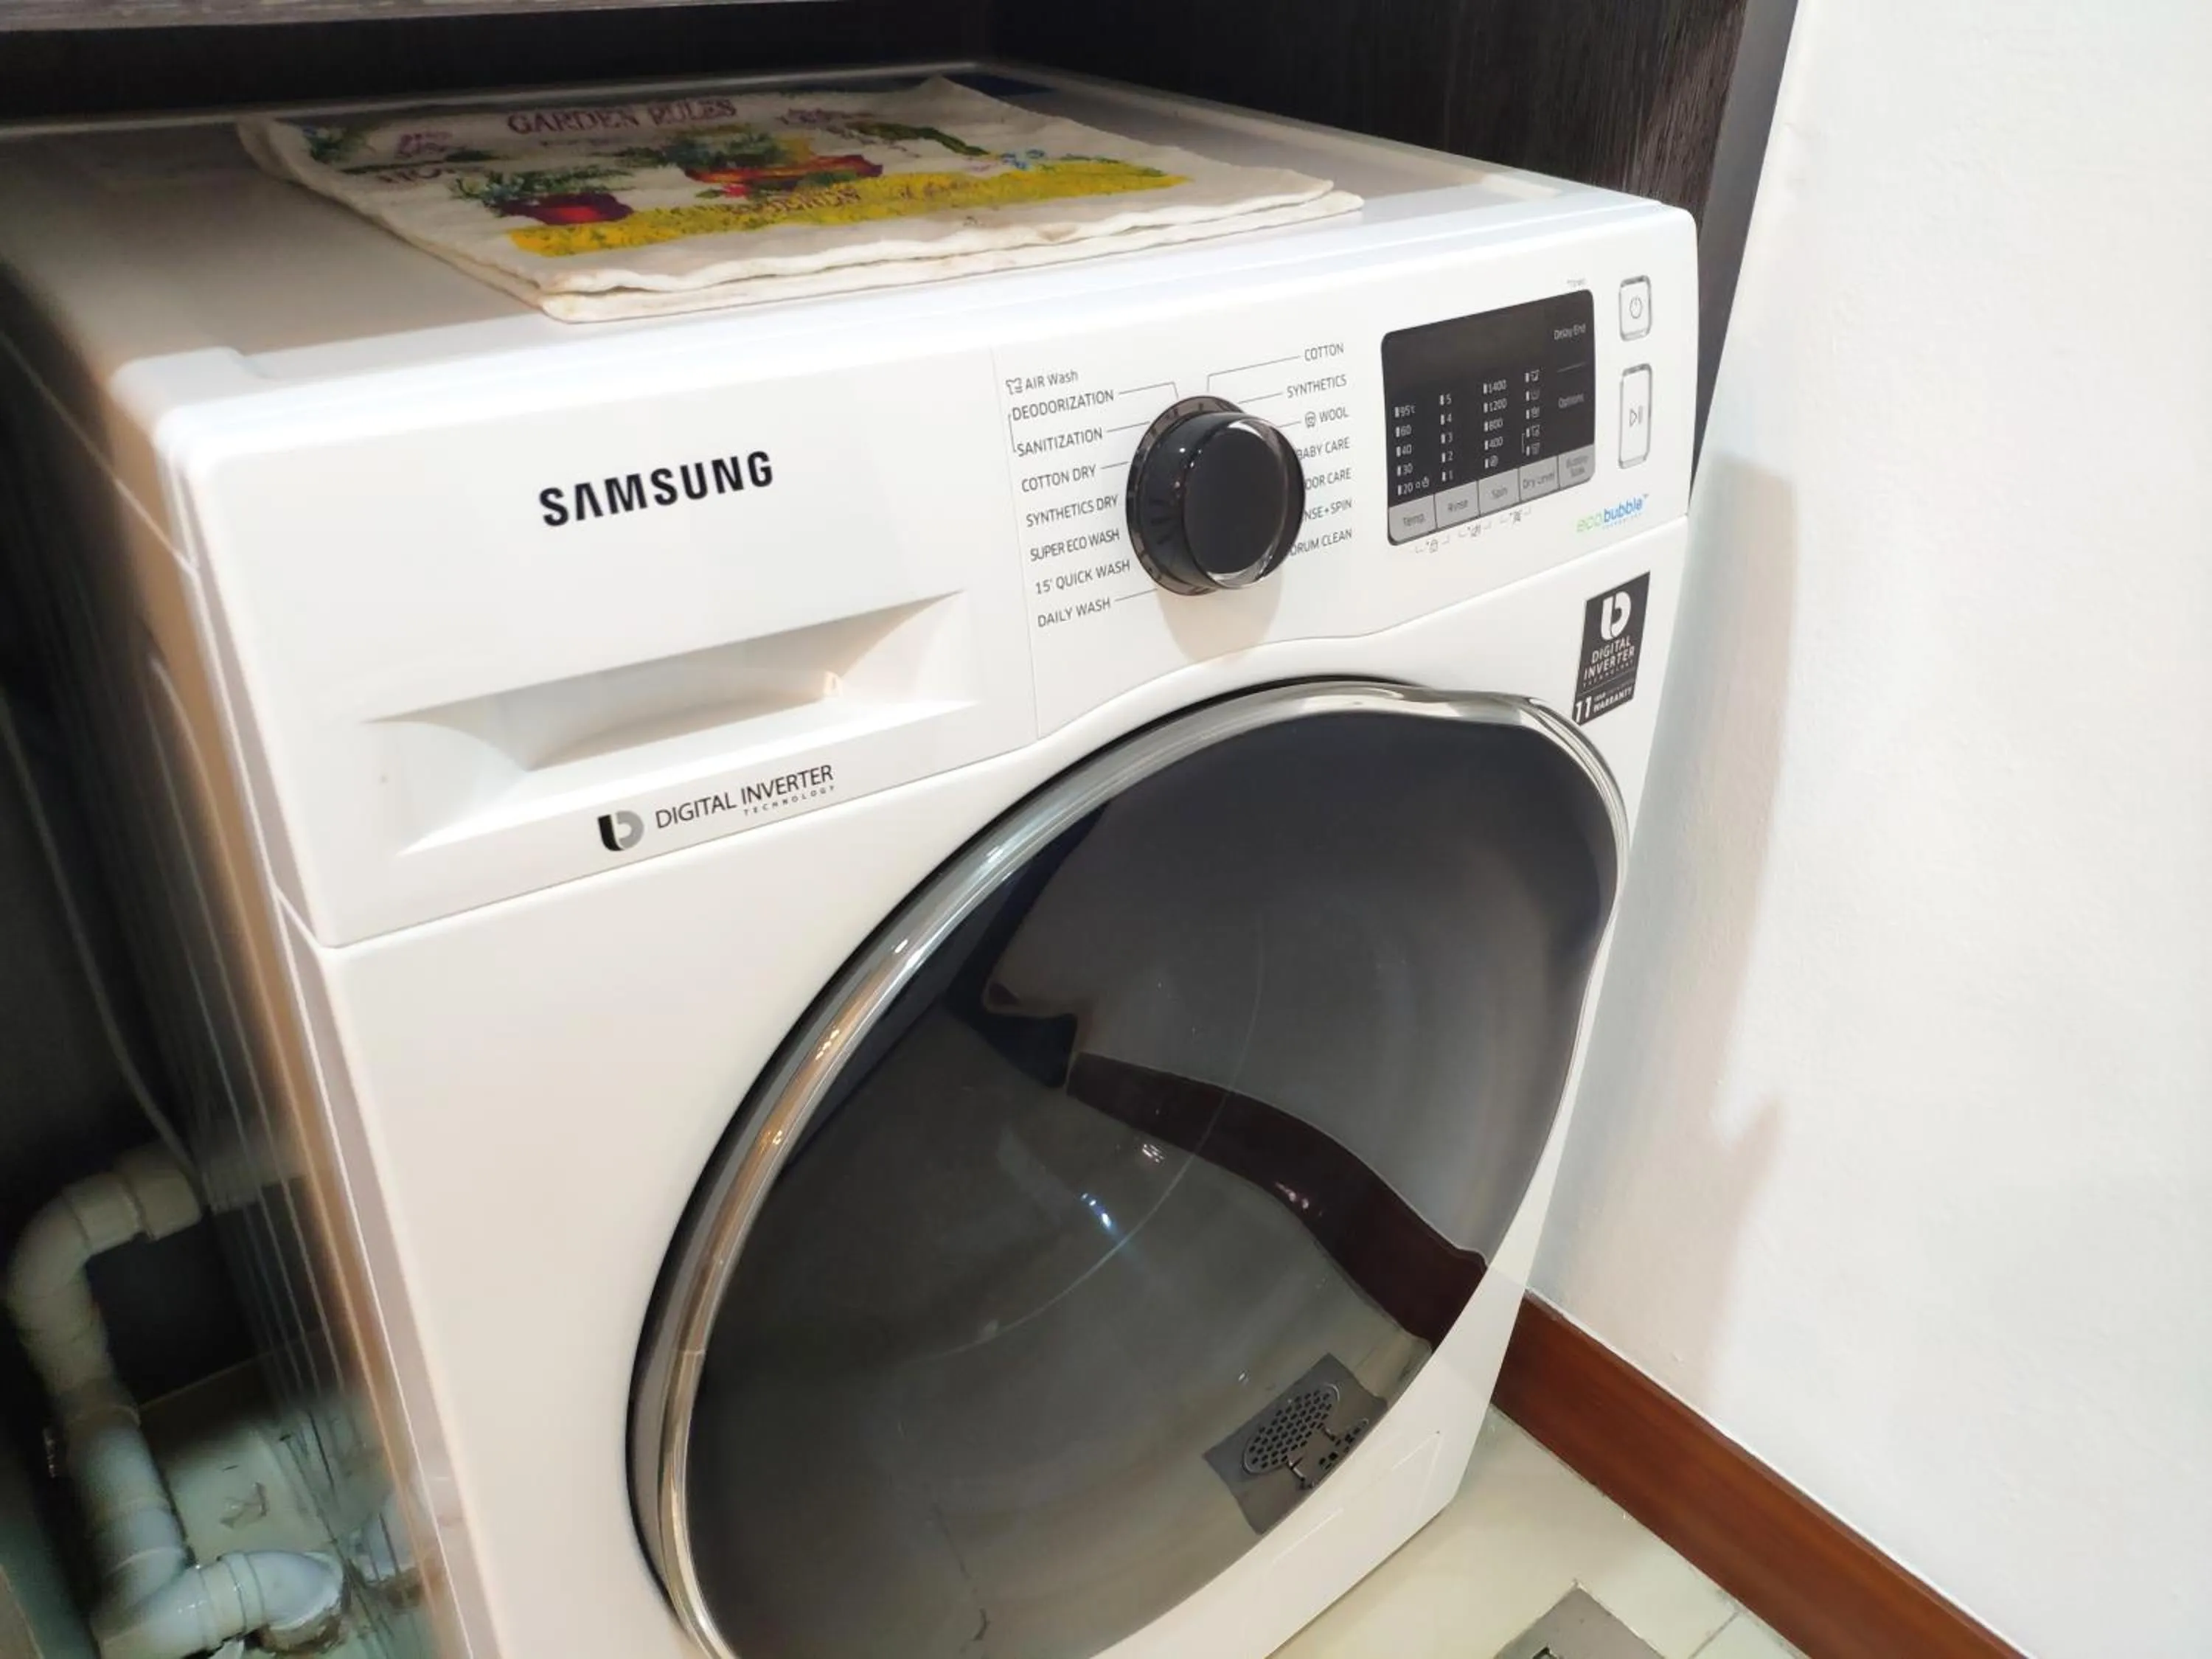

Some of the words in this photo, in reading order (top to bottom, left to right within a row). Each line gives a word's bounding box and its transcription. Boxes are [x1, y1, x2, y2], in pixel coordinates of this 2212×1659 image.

[507, 108, 640, 134] GARDEN
[647, 97, 737, 125] RULES
[1304, 342, 1344, 361] COTTON
[1025, 375, 1046, 390] AIR
[1047, 369, 1079, 386] Wash
[1287, 374, 1347, 399] SYNTHETICS
[1488, 380, 1507, 394] 1400
[1012, 389, 1115, 421] DEODORIZATION
[1445, 394, 1452, 405] 5
[1489, 398, 1507, 411] 1200
[1318, 406, 1349, 423] WOOL
[1446, 413, 1452, 423] 4
[1017, 427, 1103, 457] SANITIZATION
[1325, 437, 1351, 453] CARE
[1402, 444, 1412, 455] 40
[1402, 463, 1413, 476] 30
[1447, 451, 1453, 462] 2
[1021, 470, 1069, 493] COTTON
[1072, 465, 1096, 481] DRY
[1327, 467, 1352, 484] CARE
[1402, 482, 1413, 494] 20
[1522, 478, 1536, 490] Dry
[539, 451, 773, 527] SAMSUNG
[1026, 500, 1095, 528] SYNTHETICS
[1096, 494, 1119, 511] DRY
[1030, 541, 1065, 562] SUPER
[1066, 536, 1088, 552] ECO
[1088, 528, 1120, 546] WASH
[1290, 538, 1319, 556] DRUM
[1321, 528, 1352, 546] CLEAN
[1056, 569, 1093, 590] QUICK
[1096, 559, 1131, 579] WASH
[1037, 607, 1074, 627] DAILY
[1077, 597, 1111, 617] WASH
[1591, 635, 1632, 664] DIGITAL
[1583, 645, 1635, 681] INVERTER
[1593, 685, 1633, 713] WARRANTY
[655, 790, 737, 830] DIGITAL
[741, 765, 835, 805] INVERTER
[744, 785, 836, 817] TECHNOLOGY
